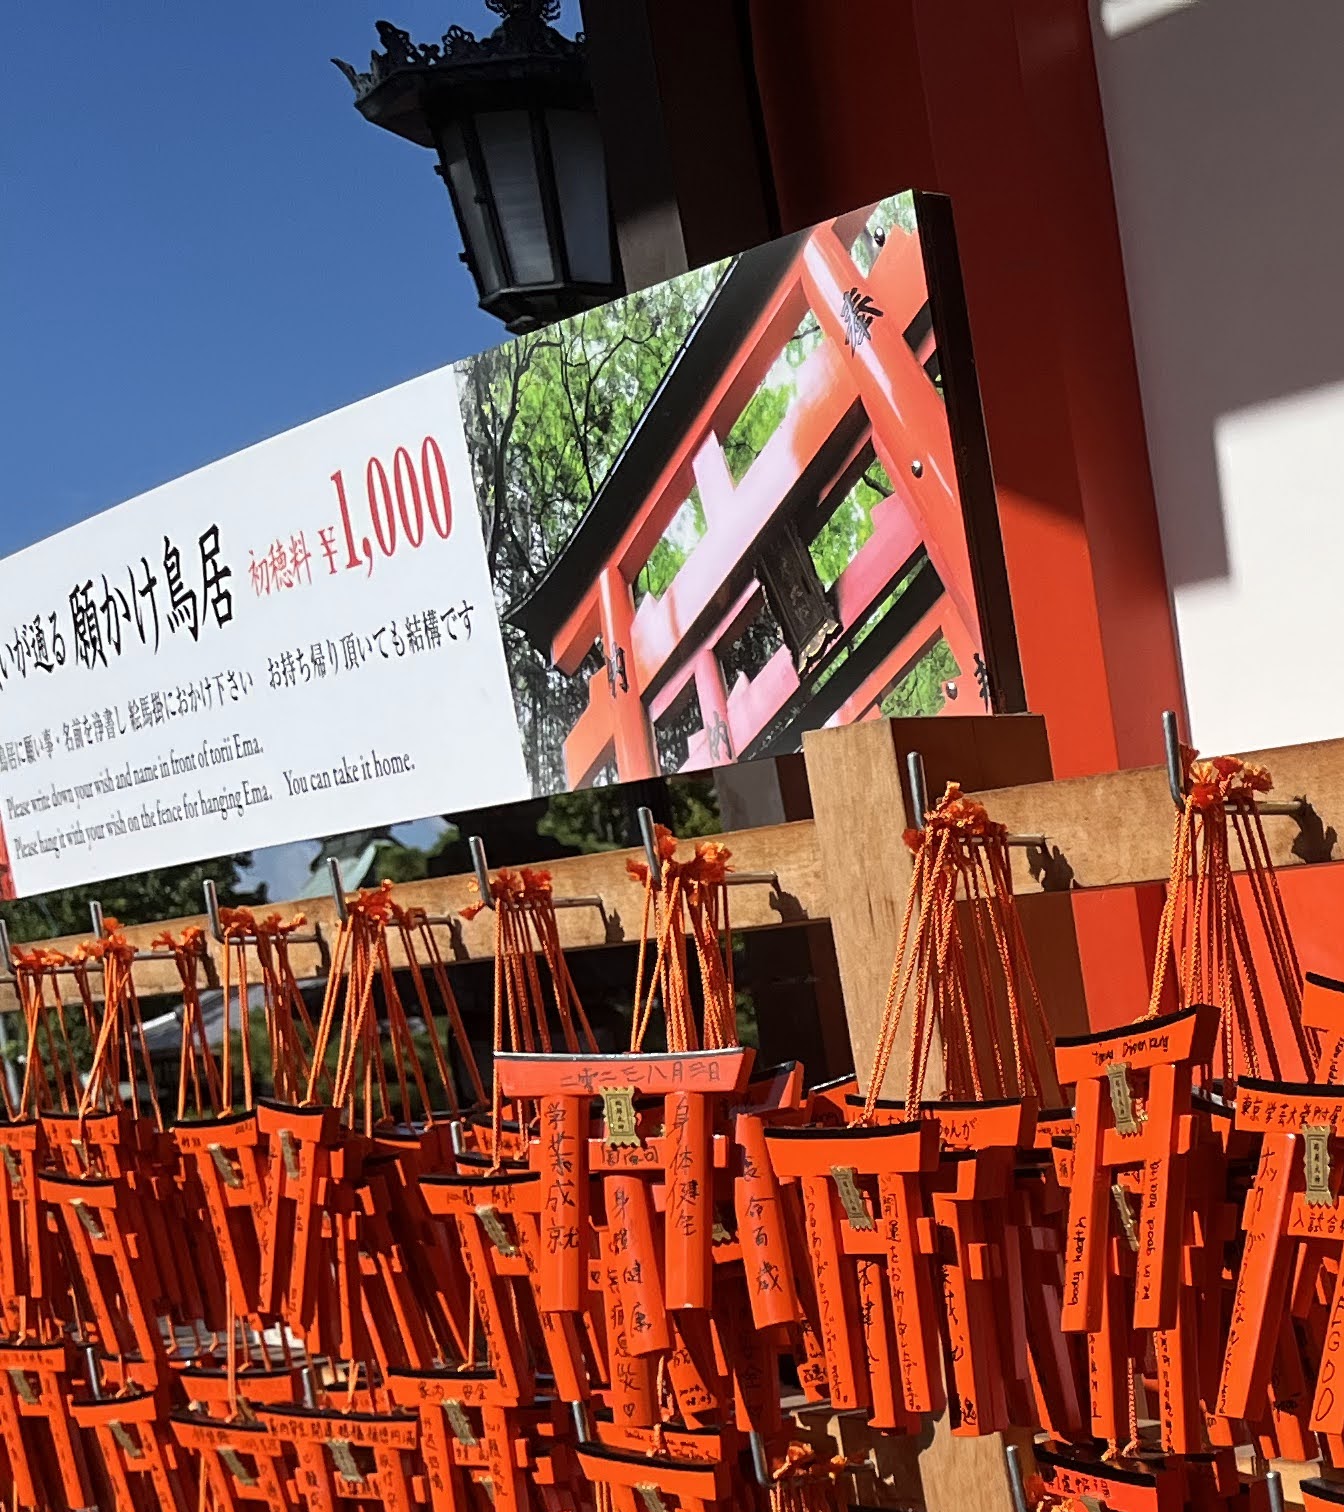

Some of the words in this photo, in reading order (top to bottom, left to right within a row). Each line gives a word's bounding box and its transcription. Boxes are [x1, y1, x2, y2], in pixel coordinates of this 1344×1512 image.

[248, 531, 312, 597] 初穂料
[318, 436, 452, 579] ¥1,000
[68, 523, 233, 668] 願かけ鳥居
[267, 599, 474, 690] お持ち帰り頂いても結構です
[95, 767, 115, 796] wish
[116, 762, 133, 790] and
[134, 765, 159, 787] name
[159, 755, 170, 780] in
[170, 749, 197, 776] front
[197, 739, 209, 767] of
[209, 736, 233, 766] torii
[233, 733, 264, 760] Ema.
[105, 811, 126, 837] wish
[127, 815, 141, 832] on
[141, 803, 156, 829] the
[157, 799, 182, 825] fence
[183, 793, 199, 819] for
[200, 788, 243, 820] hanging
[242, 779, 273, 807] Ema.
[283, 769, 308, 797] You
[310, 772, 331, 791] can
[332, 757, 360, 786] take
[360, 754, 372, 781] it
[372, 749, 416, 778] home.
